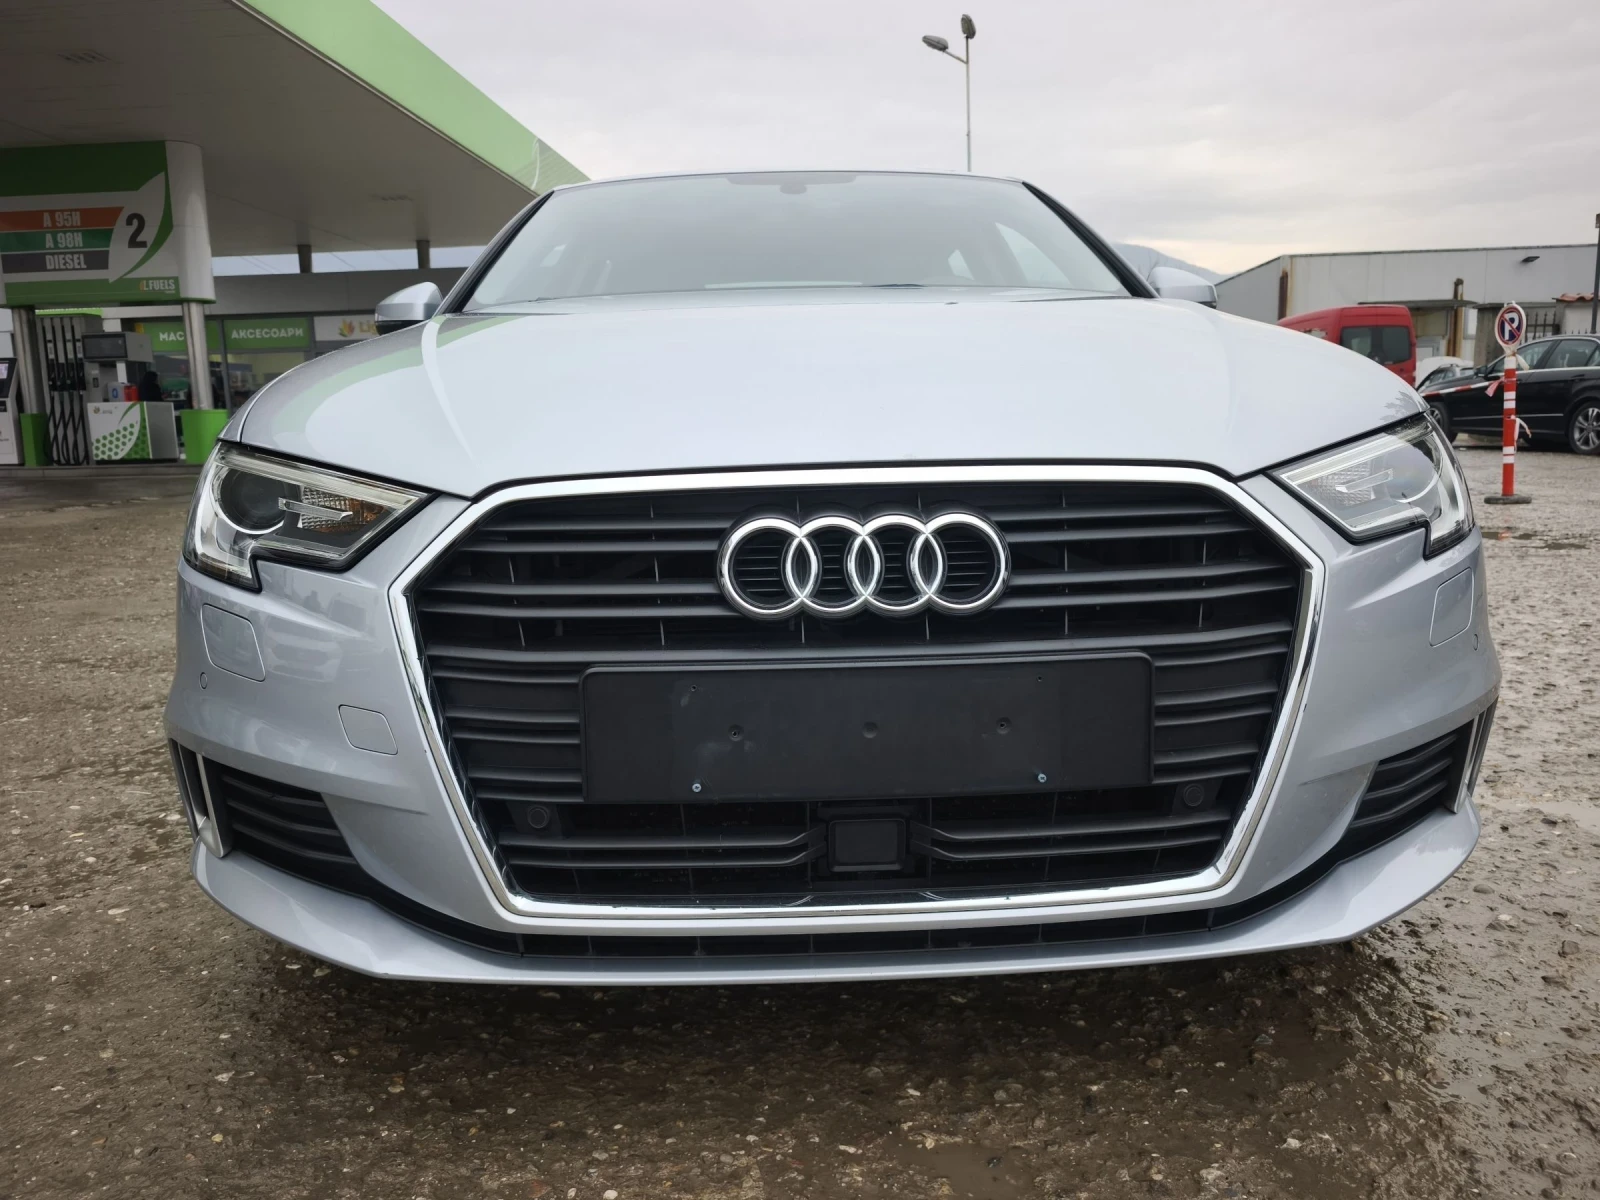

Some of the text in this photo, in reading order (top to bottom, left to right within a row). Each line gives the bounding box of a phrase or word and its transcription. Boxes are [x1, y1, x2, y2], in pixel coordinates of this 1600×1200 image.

[125, 212, 148, 249] 2
[45, 254, 87, 270] DIESEL
[231, 327, 304, 339] АКСЕСОАРИ
